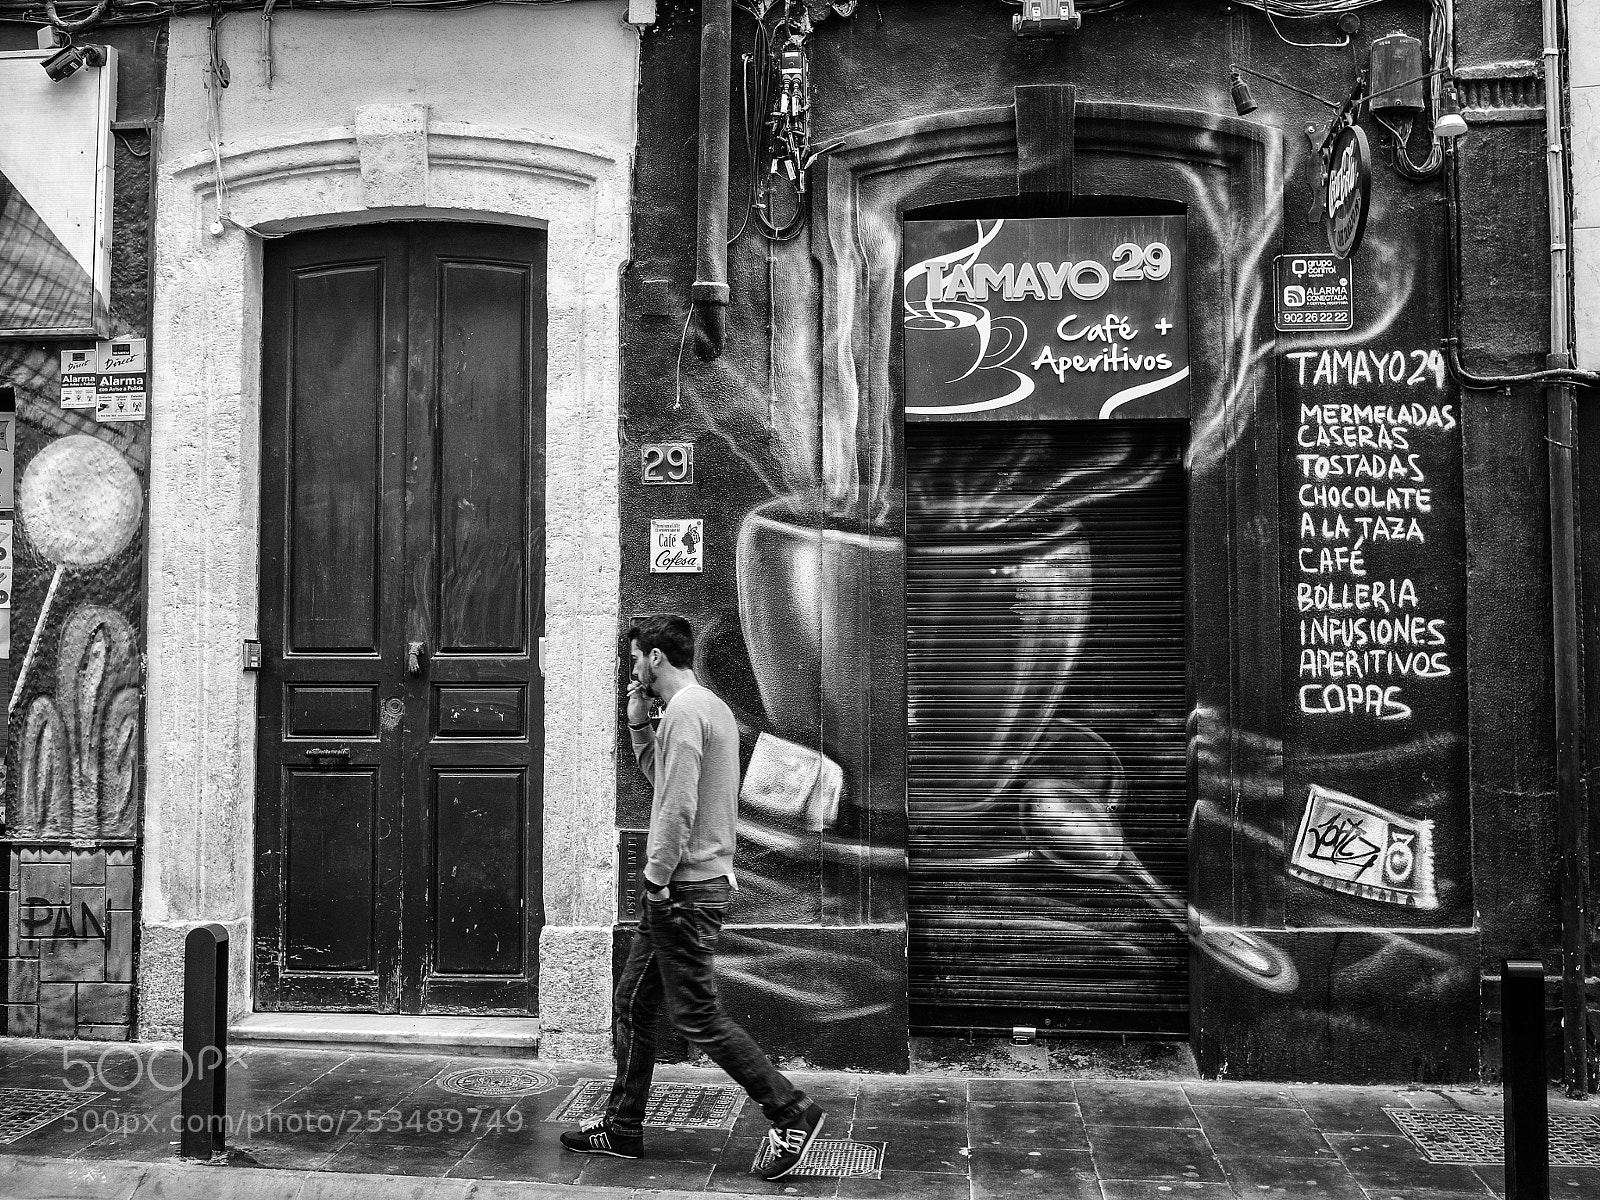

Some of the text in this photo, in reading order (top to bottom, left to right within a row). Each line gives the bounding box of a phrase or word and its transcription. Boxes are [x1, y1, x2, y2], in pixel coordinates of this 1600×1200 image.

[925, 242, 1171, 301] TAMAYO 29
[1307, 259, 1333, 268] grupo
[1306, 286, 1348, 296] ALARMA
[1057, 314, 1138, 342] Café
[1283, 311, 1348, 323] 902 26 22 22
[105, 354, 139, 370] Direct
[1031, 343, 1173, 383] Aperitivos
[62, 374, 96, 382] Alarma
[100, 376, 144, 386] Alarma
[1300, 402, 1456, 430] MERMELADAS
[1297, 424, 1409, 450] CASERAS
[644, 447, 688, 480] 29
[1297, 454, 1424, 482] TOSTADAS
[1299, 484, 1432, 512] CHOCOLATE
[658, 533, 677, 547] Café
[1301, 512, 1424, 543] A LA TAZA
[655, 549, 697, 570] Cofesa
[1299, 536, 1366, 575] CAFÉ
[1297, 578, 1418, 613] BOLLERIA
[1300, 613, 1446, 646] INFUSIONES
[1300, 648, 1451, 679] APERITIVOS
[1300, 684, 1412, 720] COPAS
[626, 889, 636, 915] PASO
[21, 896, 112, 950] PAN
